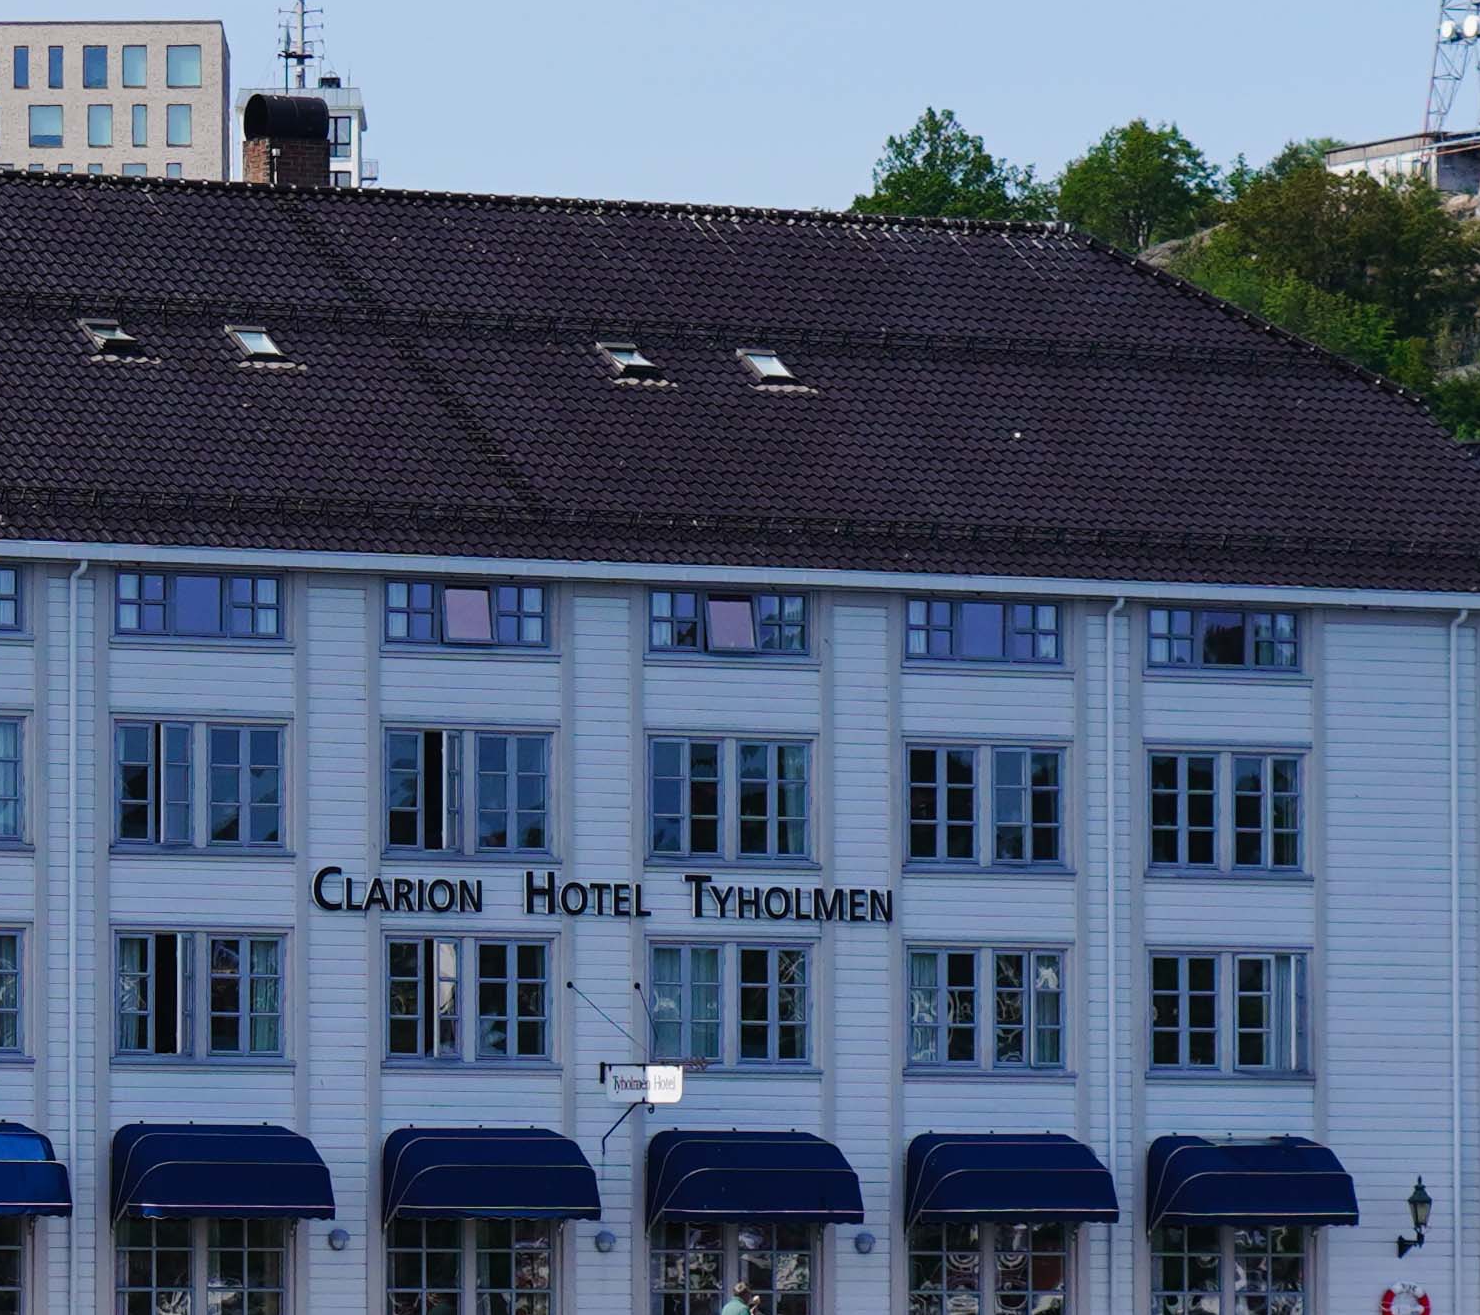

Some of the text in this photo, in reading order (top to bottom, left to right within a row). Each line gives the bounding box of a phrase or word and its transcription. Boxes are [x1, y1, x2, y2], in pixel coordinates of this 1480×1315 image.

[311, 865, 893, 922] CLARION HOTEL TYHOLMEN
[653, 1074, 676, 1091] Hotel
